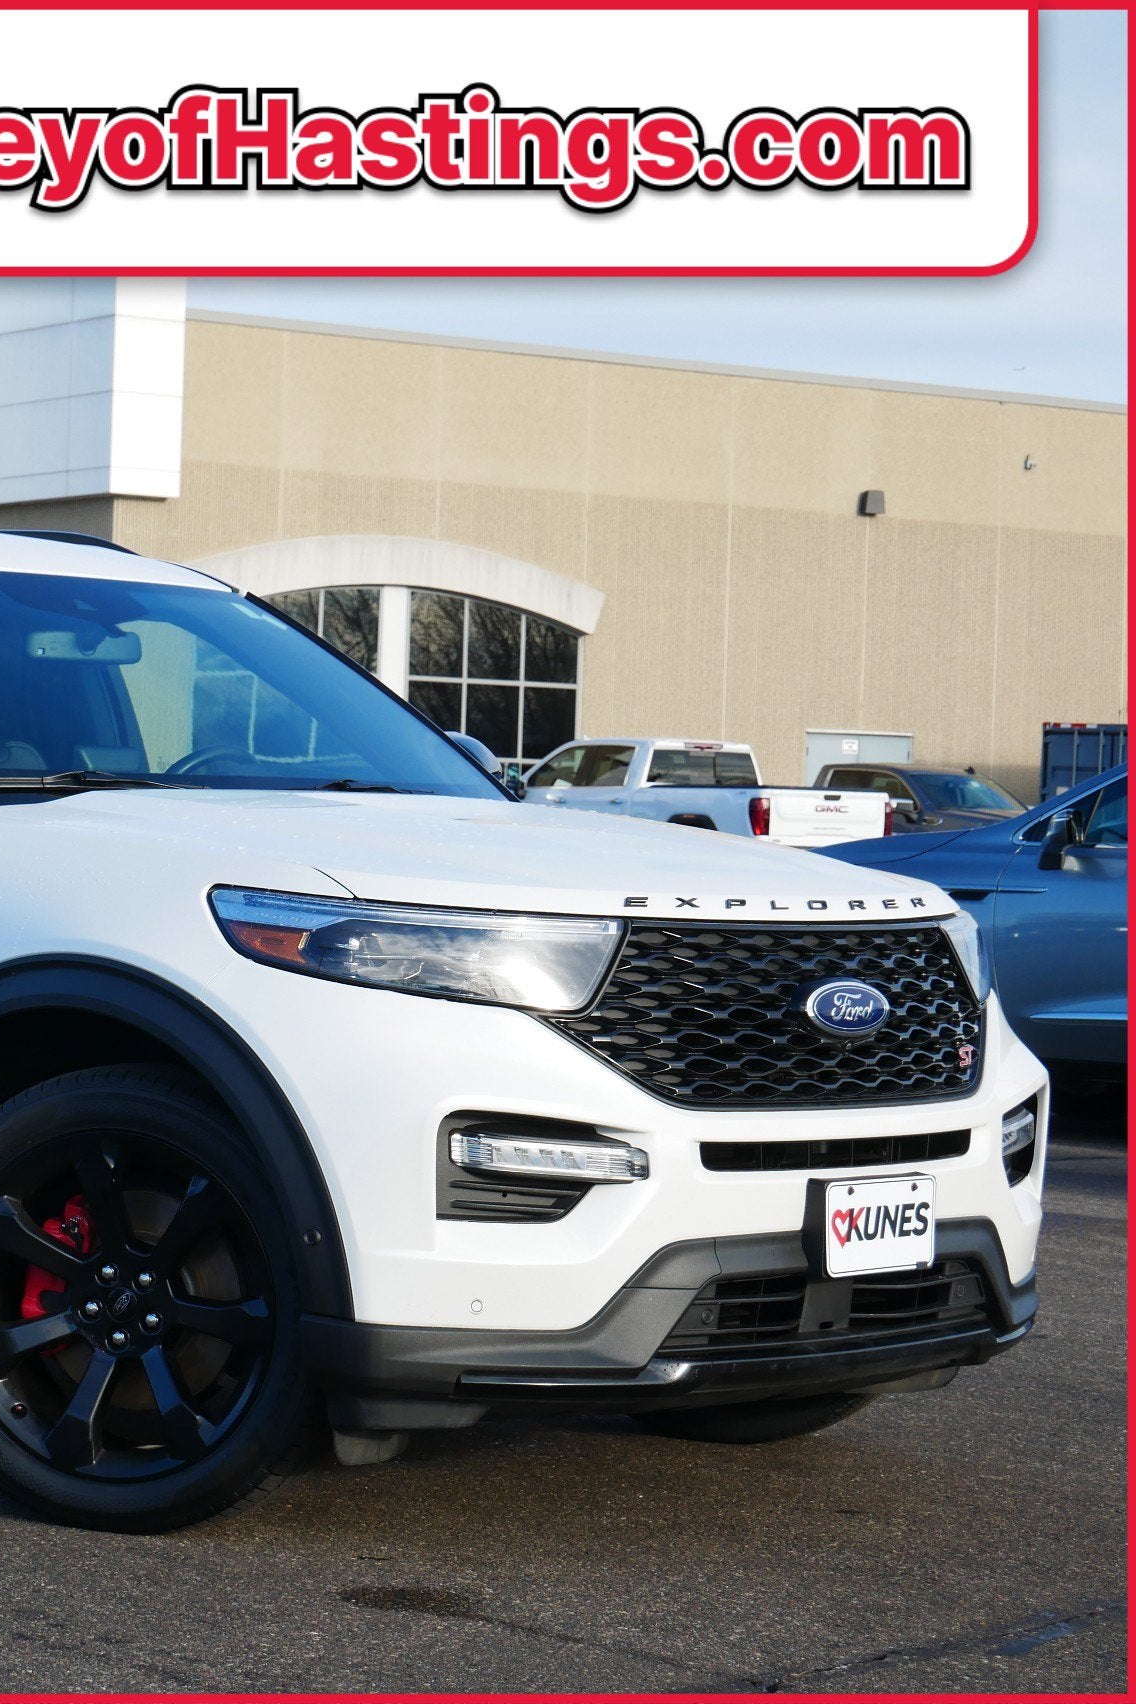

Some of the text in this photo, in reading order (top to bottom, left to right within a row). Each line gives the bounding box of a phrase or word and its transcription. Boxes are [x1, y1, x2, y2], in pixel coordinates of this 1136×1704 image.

[815, 804, 849, 814] GMC
[623, 895, 927, 913] EXPLORER
[830, 992, 875, 1021] Ford
[845, 1201, 931, 1243] KUNES
